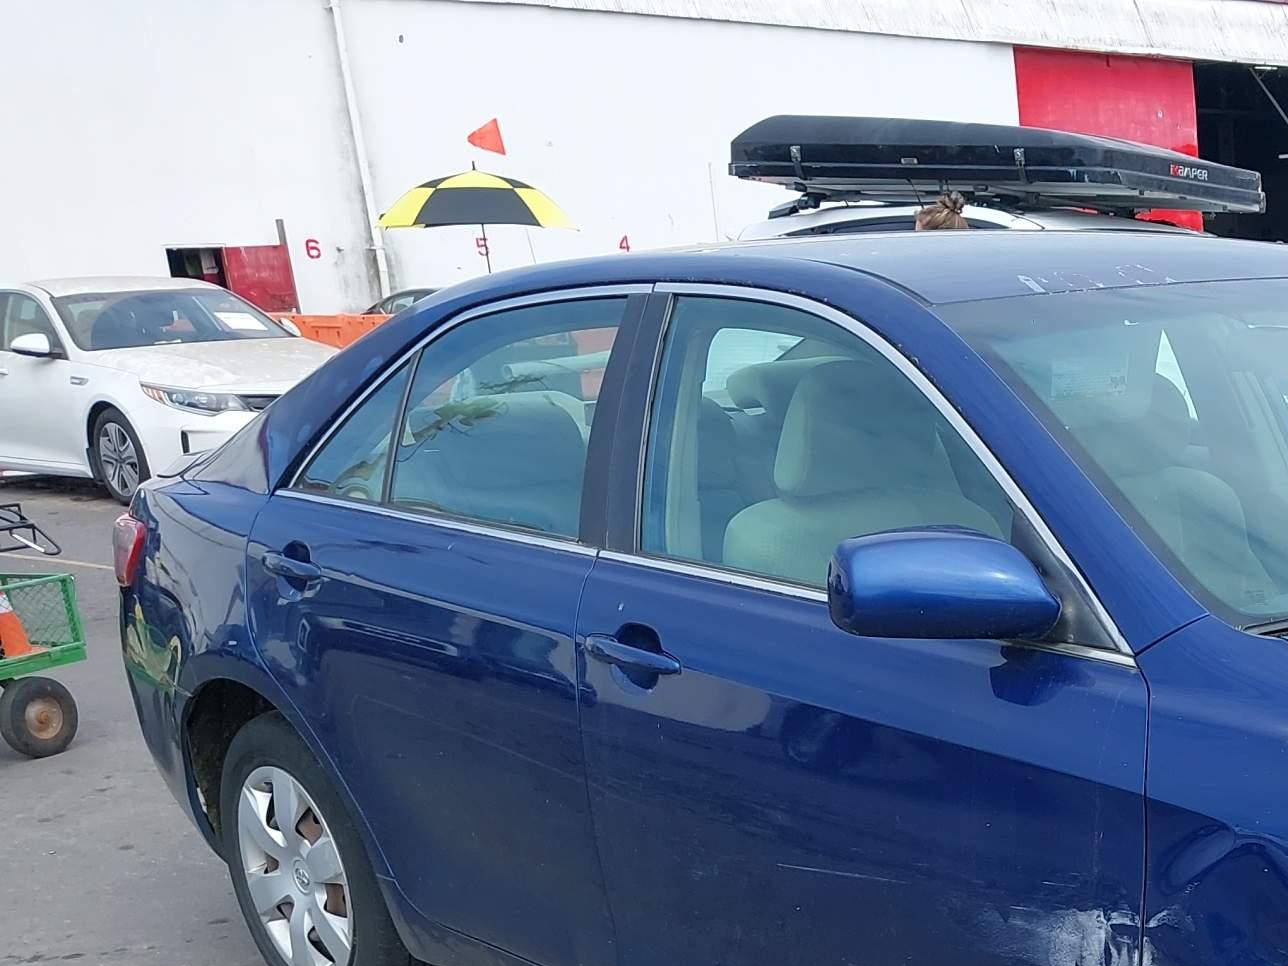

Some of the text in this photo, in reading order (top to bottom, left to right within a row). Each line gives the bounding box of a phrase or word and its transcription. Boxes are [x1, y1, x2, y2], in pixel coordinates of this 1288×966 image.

[305, 239, 321, 259] 6
[475, 237, 489, 256] 5
[619, 235, 630, 252] 4
